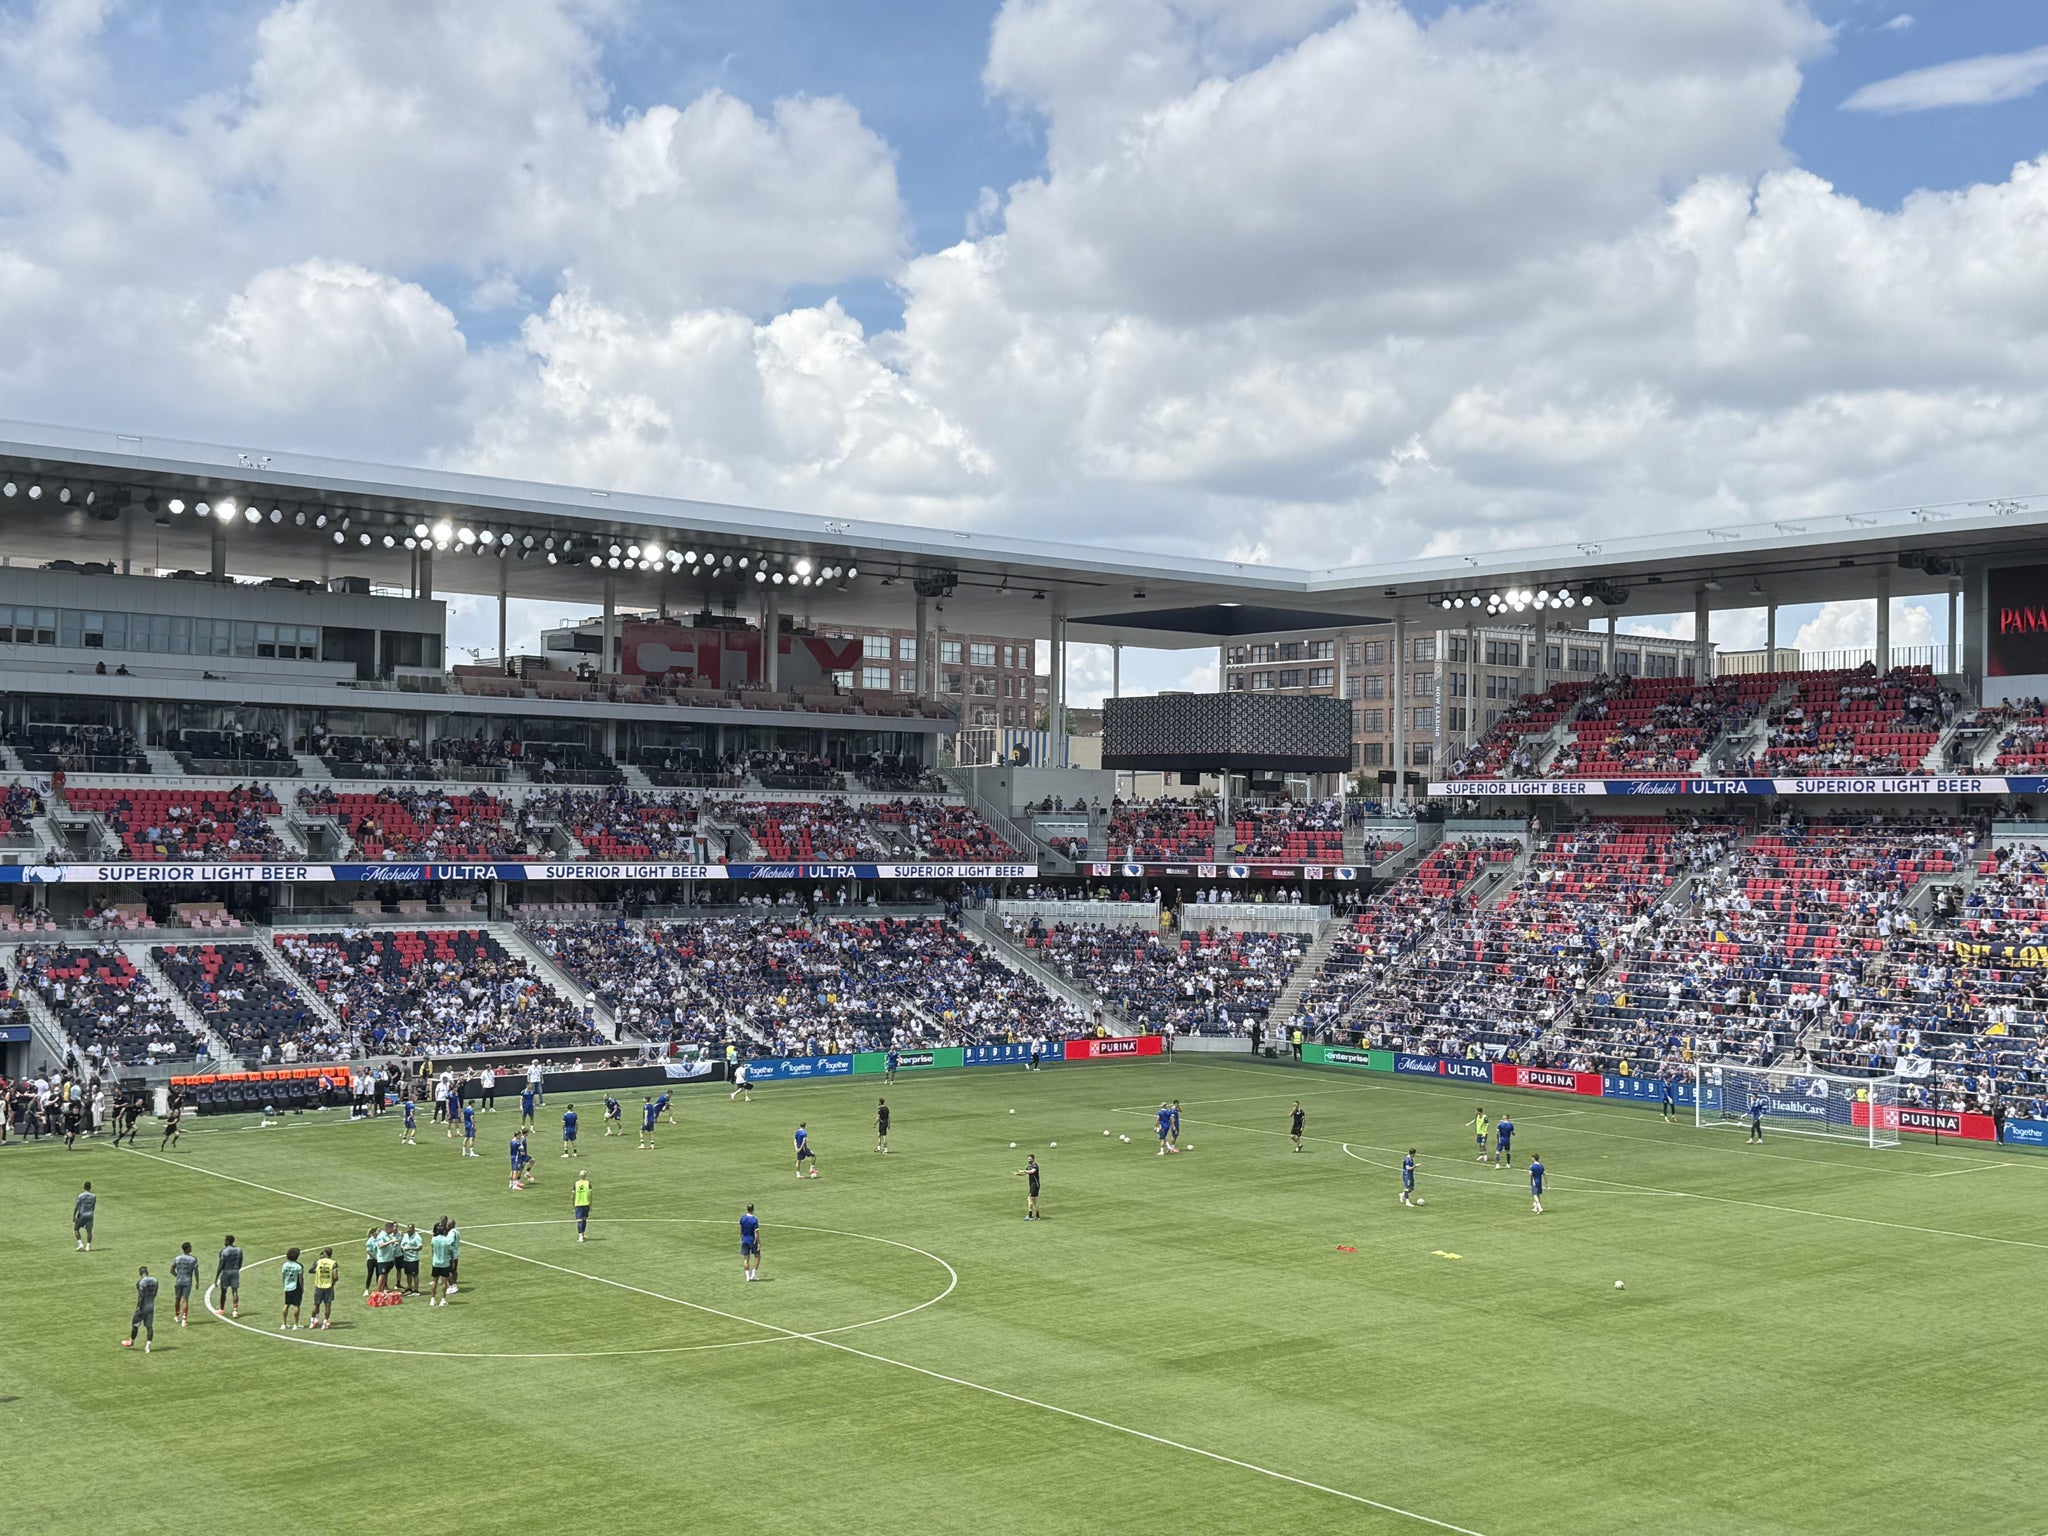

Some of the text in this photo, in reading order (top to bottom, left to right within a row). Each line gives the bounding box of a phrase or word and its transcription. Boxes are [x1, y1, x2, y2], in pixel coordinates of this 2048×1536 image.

[1446, 783, 1586, 794] SUPERIOR LIGHT BEER
[1627, 781, 1748, 795] Michelob ULTRA
[1795, 779, 1981, 793] SUPERIOR LIGHT BEER
[98, 866, 307, 881] SUPERIOR LIGHT BEER
[361, 866, 498, 882] Michelob ULTRA
[546, 866, 707, 879] SUPERIOR LIGHT BEER
[748, 865, 856, 879] Michelob ULTRA
[894, 866, 1024, 877] SUPERIOR LIGHT BEER
[1101, 1042, 1135, 1052] PURINA
[1327, 1052, 1368, 1063] enterprise
[750, 1066, 774, 1076] Together
[789, 1063, 812, 1073] Together
[826, 1061, 849, 1070] Together
[1398, 1057, 1488, 1078] Michelob ULTRA
[1531, 1072, 1573, 1086] PURINA
[1772, 1099, 1826, 1115] HealthCare
[1902, 1113, 1957, 1129] PURINA
[2011, 1126, 2043, 1138] Together
